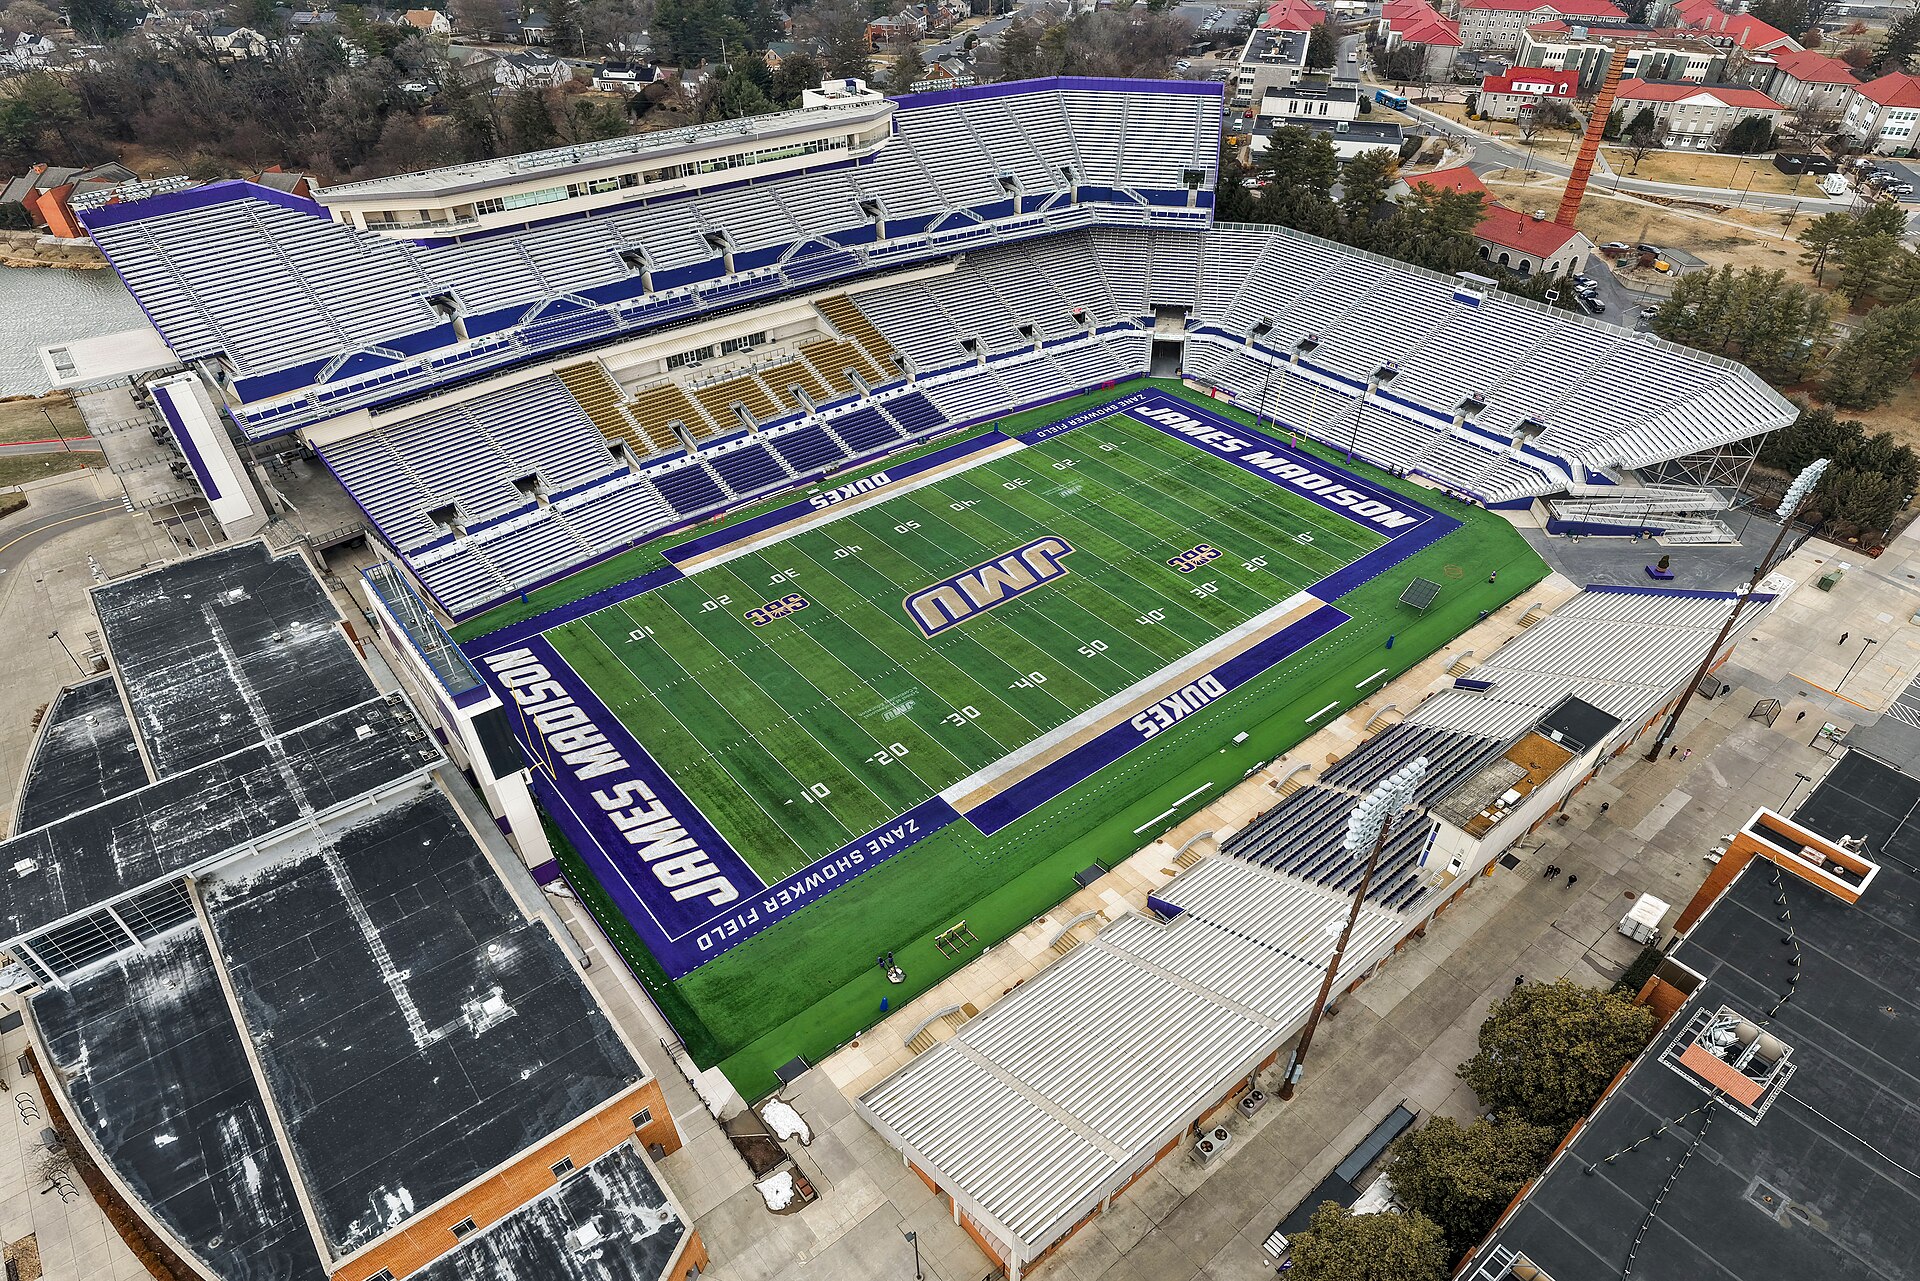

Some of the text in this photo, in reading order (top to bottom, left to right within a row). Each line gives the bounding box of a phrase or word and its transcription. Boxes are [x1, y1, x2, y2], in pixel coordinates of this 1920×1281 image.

[1036, 394, 1147, 438] ZANE SHOWKER FIELD
[1099, 442, 1118, 451] 10
[1052, 459, 1077, 470] 20
[1133, 406, 1419, 529] JAMES MADISON
[809, 471, 892, 511] DUKES
[1002, 478, 1028, 490] 30
[950, 500, 977, 511] 40
[894, 519, 921, 534] 50
[1292, 533, 1315, 546] 10
[834, 545, 863, 558] 40
[1166, 543, 1223, 573] SBC
[1241, 557, 1268, 572] 20
[770, 568, 800, 584] 30
[910, 537, 1068, 631] JMU
[1190, 582, 1219, 599] 30
[702, 594, 733, 611] 20
[744, 593, 810, 627] SBC
[1136, 609, 1166, 626] 40
[629, 625, 655, 641] 10
[1077, 639, 1109, 658] 50
[1013, 671, 1048, 689] 40
[882, 700, 916, 722] JMU
[1131, 674, 1228, 739] DUKES
[946, 705, 981, 727] 30
[873, 742, 909, 766] 20
[482, 647, 740, 907] JAMES MADISON
[800, 782, 831, 804] 10
[696, 818, 920, 951] ZANE SHOWKER FIELD
